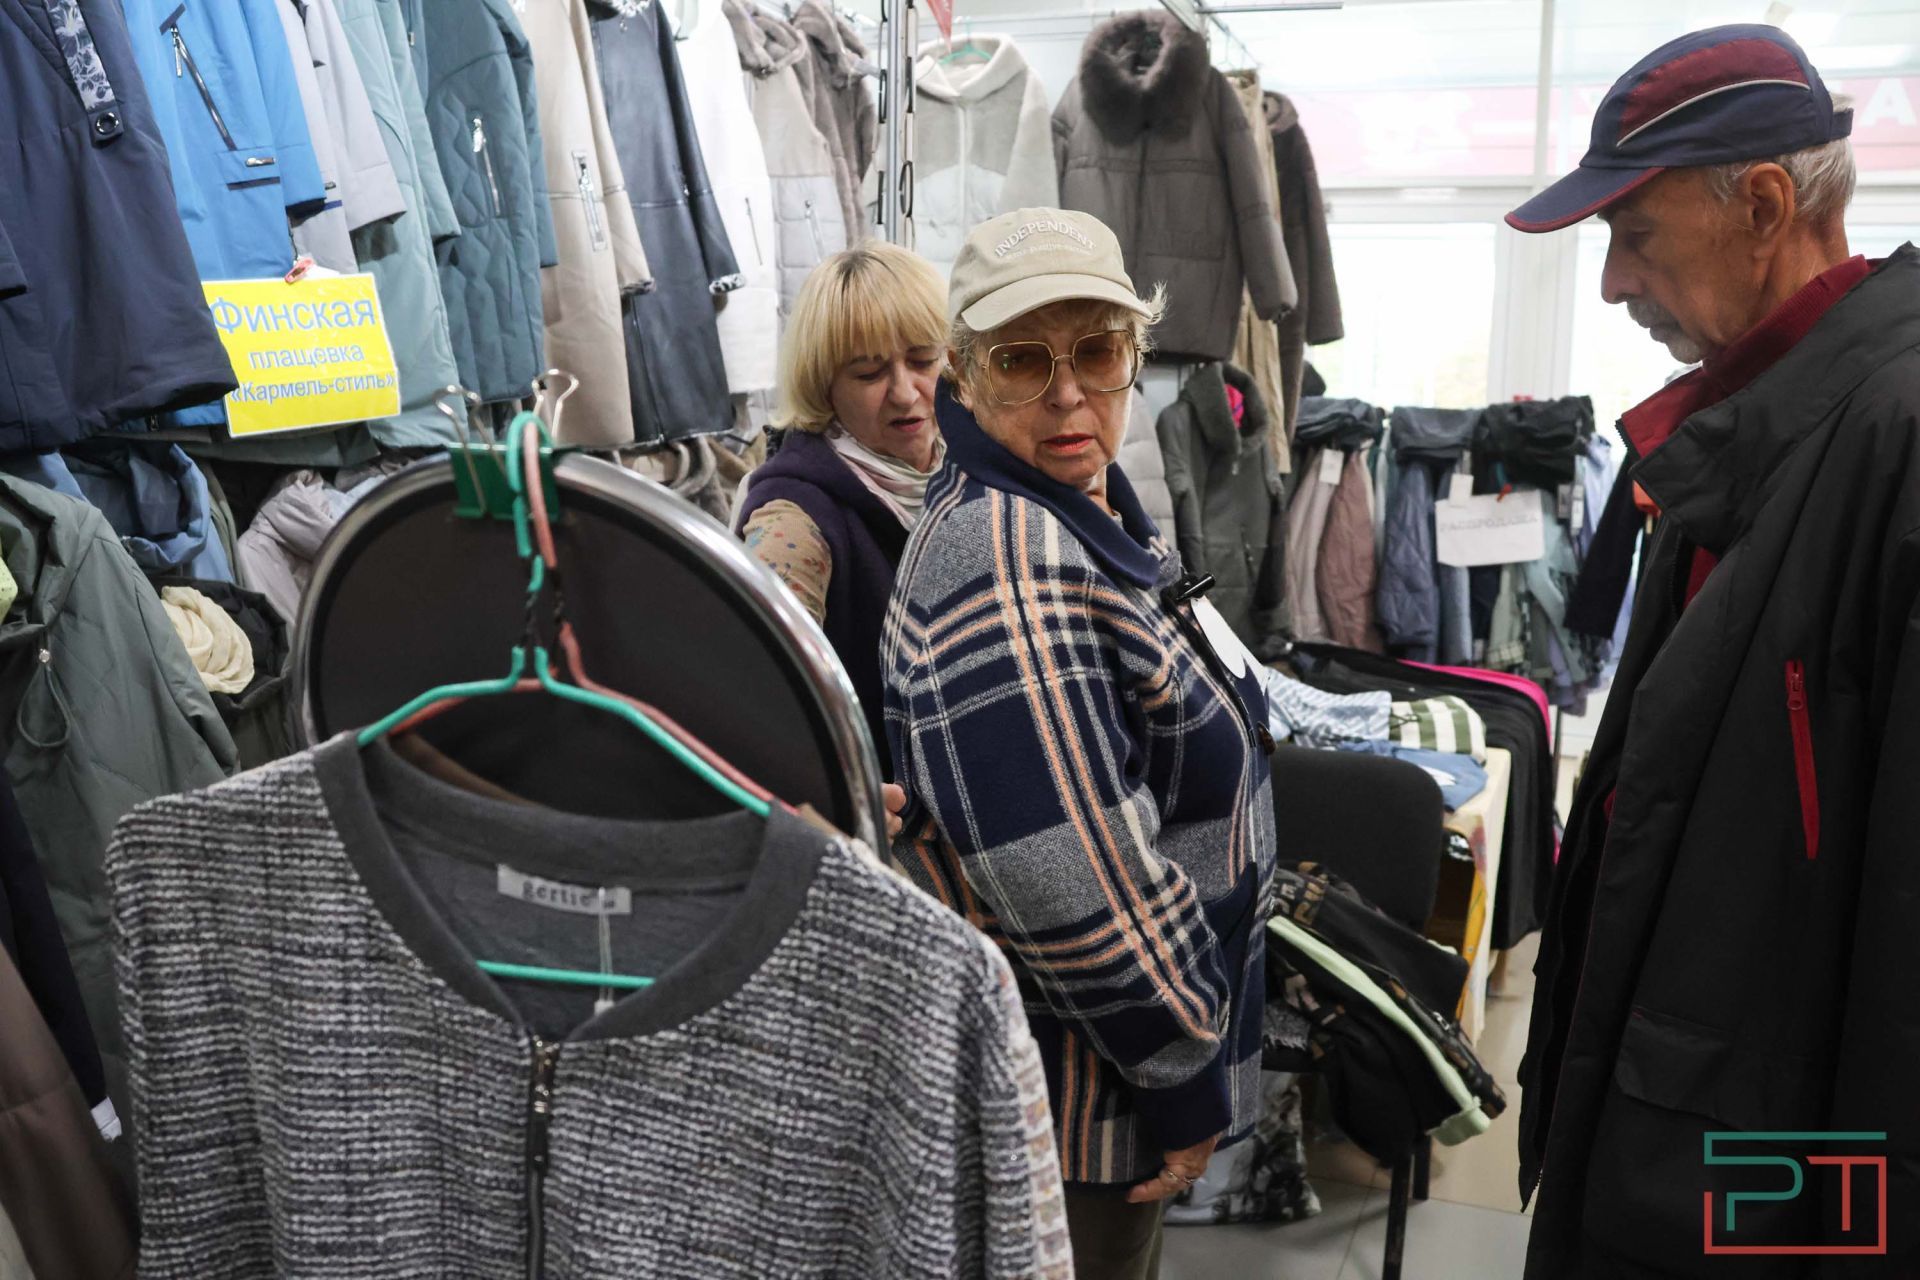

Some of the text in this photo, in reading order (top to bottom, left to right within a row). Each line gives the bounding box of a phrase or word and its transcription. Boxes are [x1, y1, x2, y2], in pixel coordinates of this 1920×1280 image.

[995, 220, 1097, 257] INDEPENDENT
[209, 297, 375, 334] Финская
[249, 344, 365, 369] плащевка
[231, 373, 394, 405] «Кармель-стиль»
